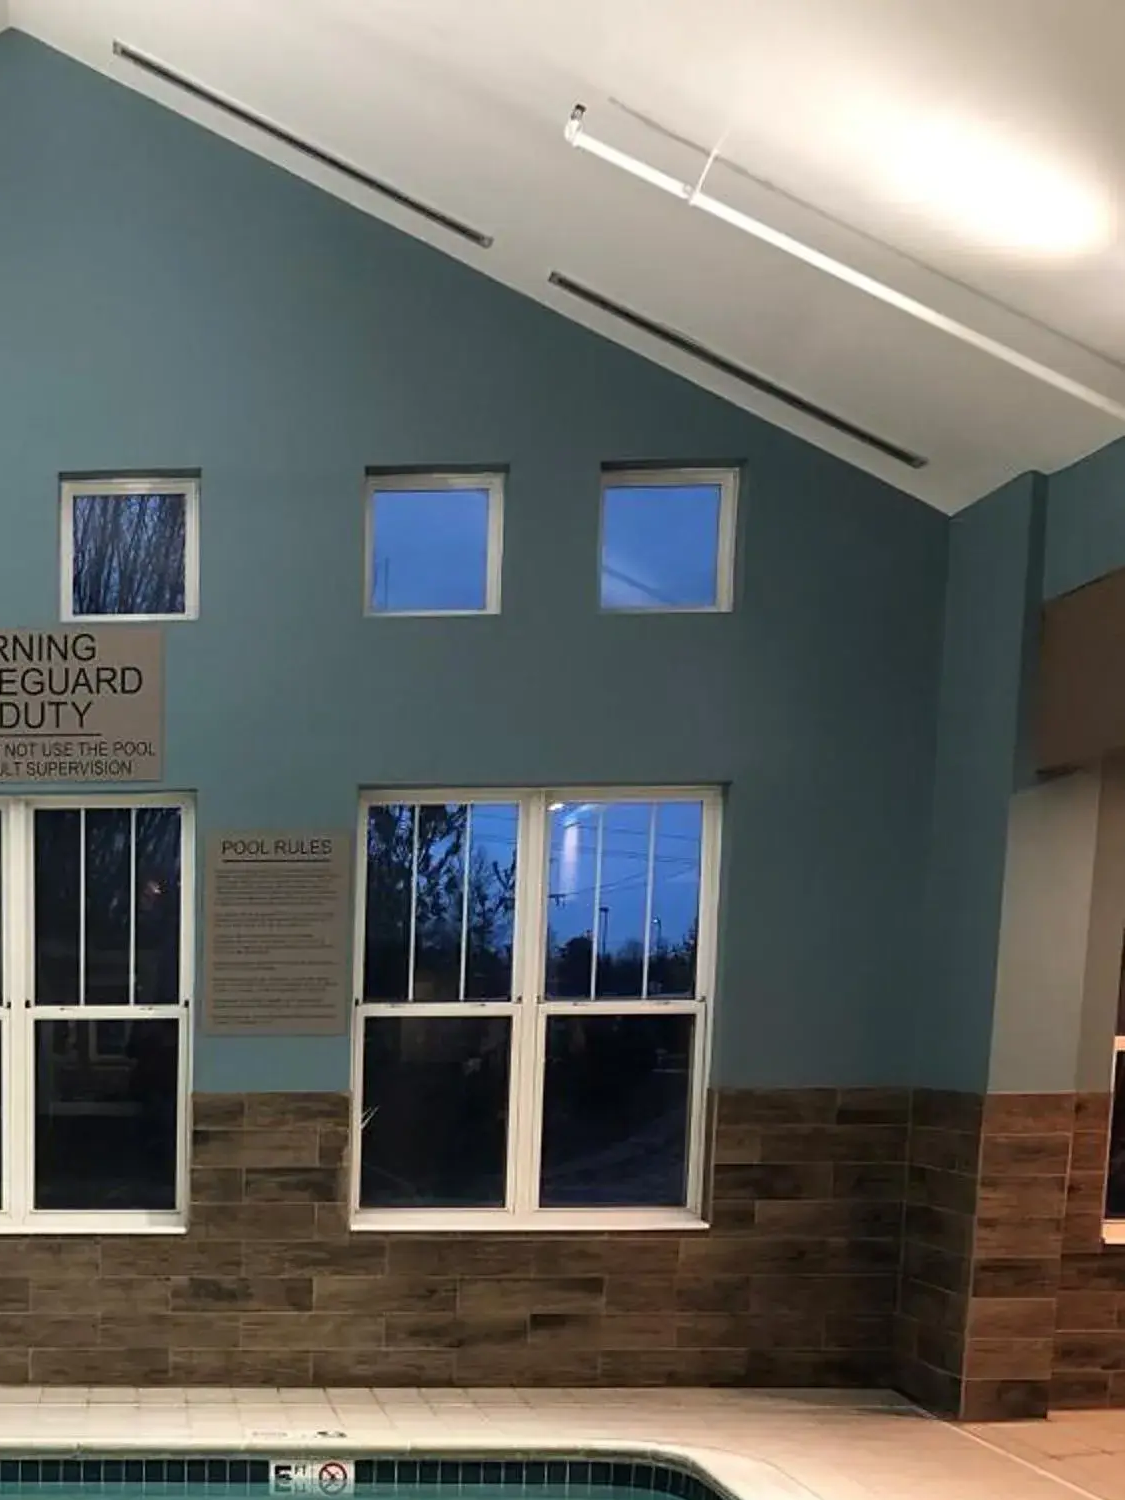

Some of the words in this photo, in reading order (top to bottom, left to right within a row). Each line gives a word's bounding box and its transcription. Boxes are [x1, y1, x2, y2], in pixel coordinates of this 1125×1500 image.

[0, 701, 93, 729] DUTY
[5, 742, 37, 758] NOT
[42, 742, 73, 757] USE
[78, 742, 108, 757] THE
[113, 741, 155, 756] POOL
[26, 760, 132, 776] SUPERVISION
[221, 840, 269, 855] POOL
[275, 839, 332, 855] RULES
